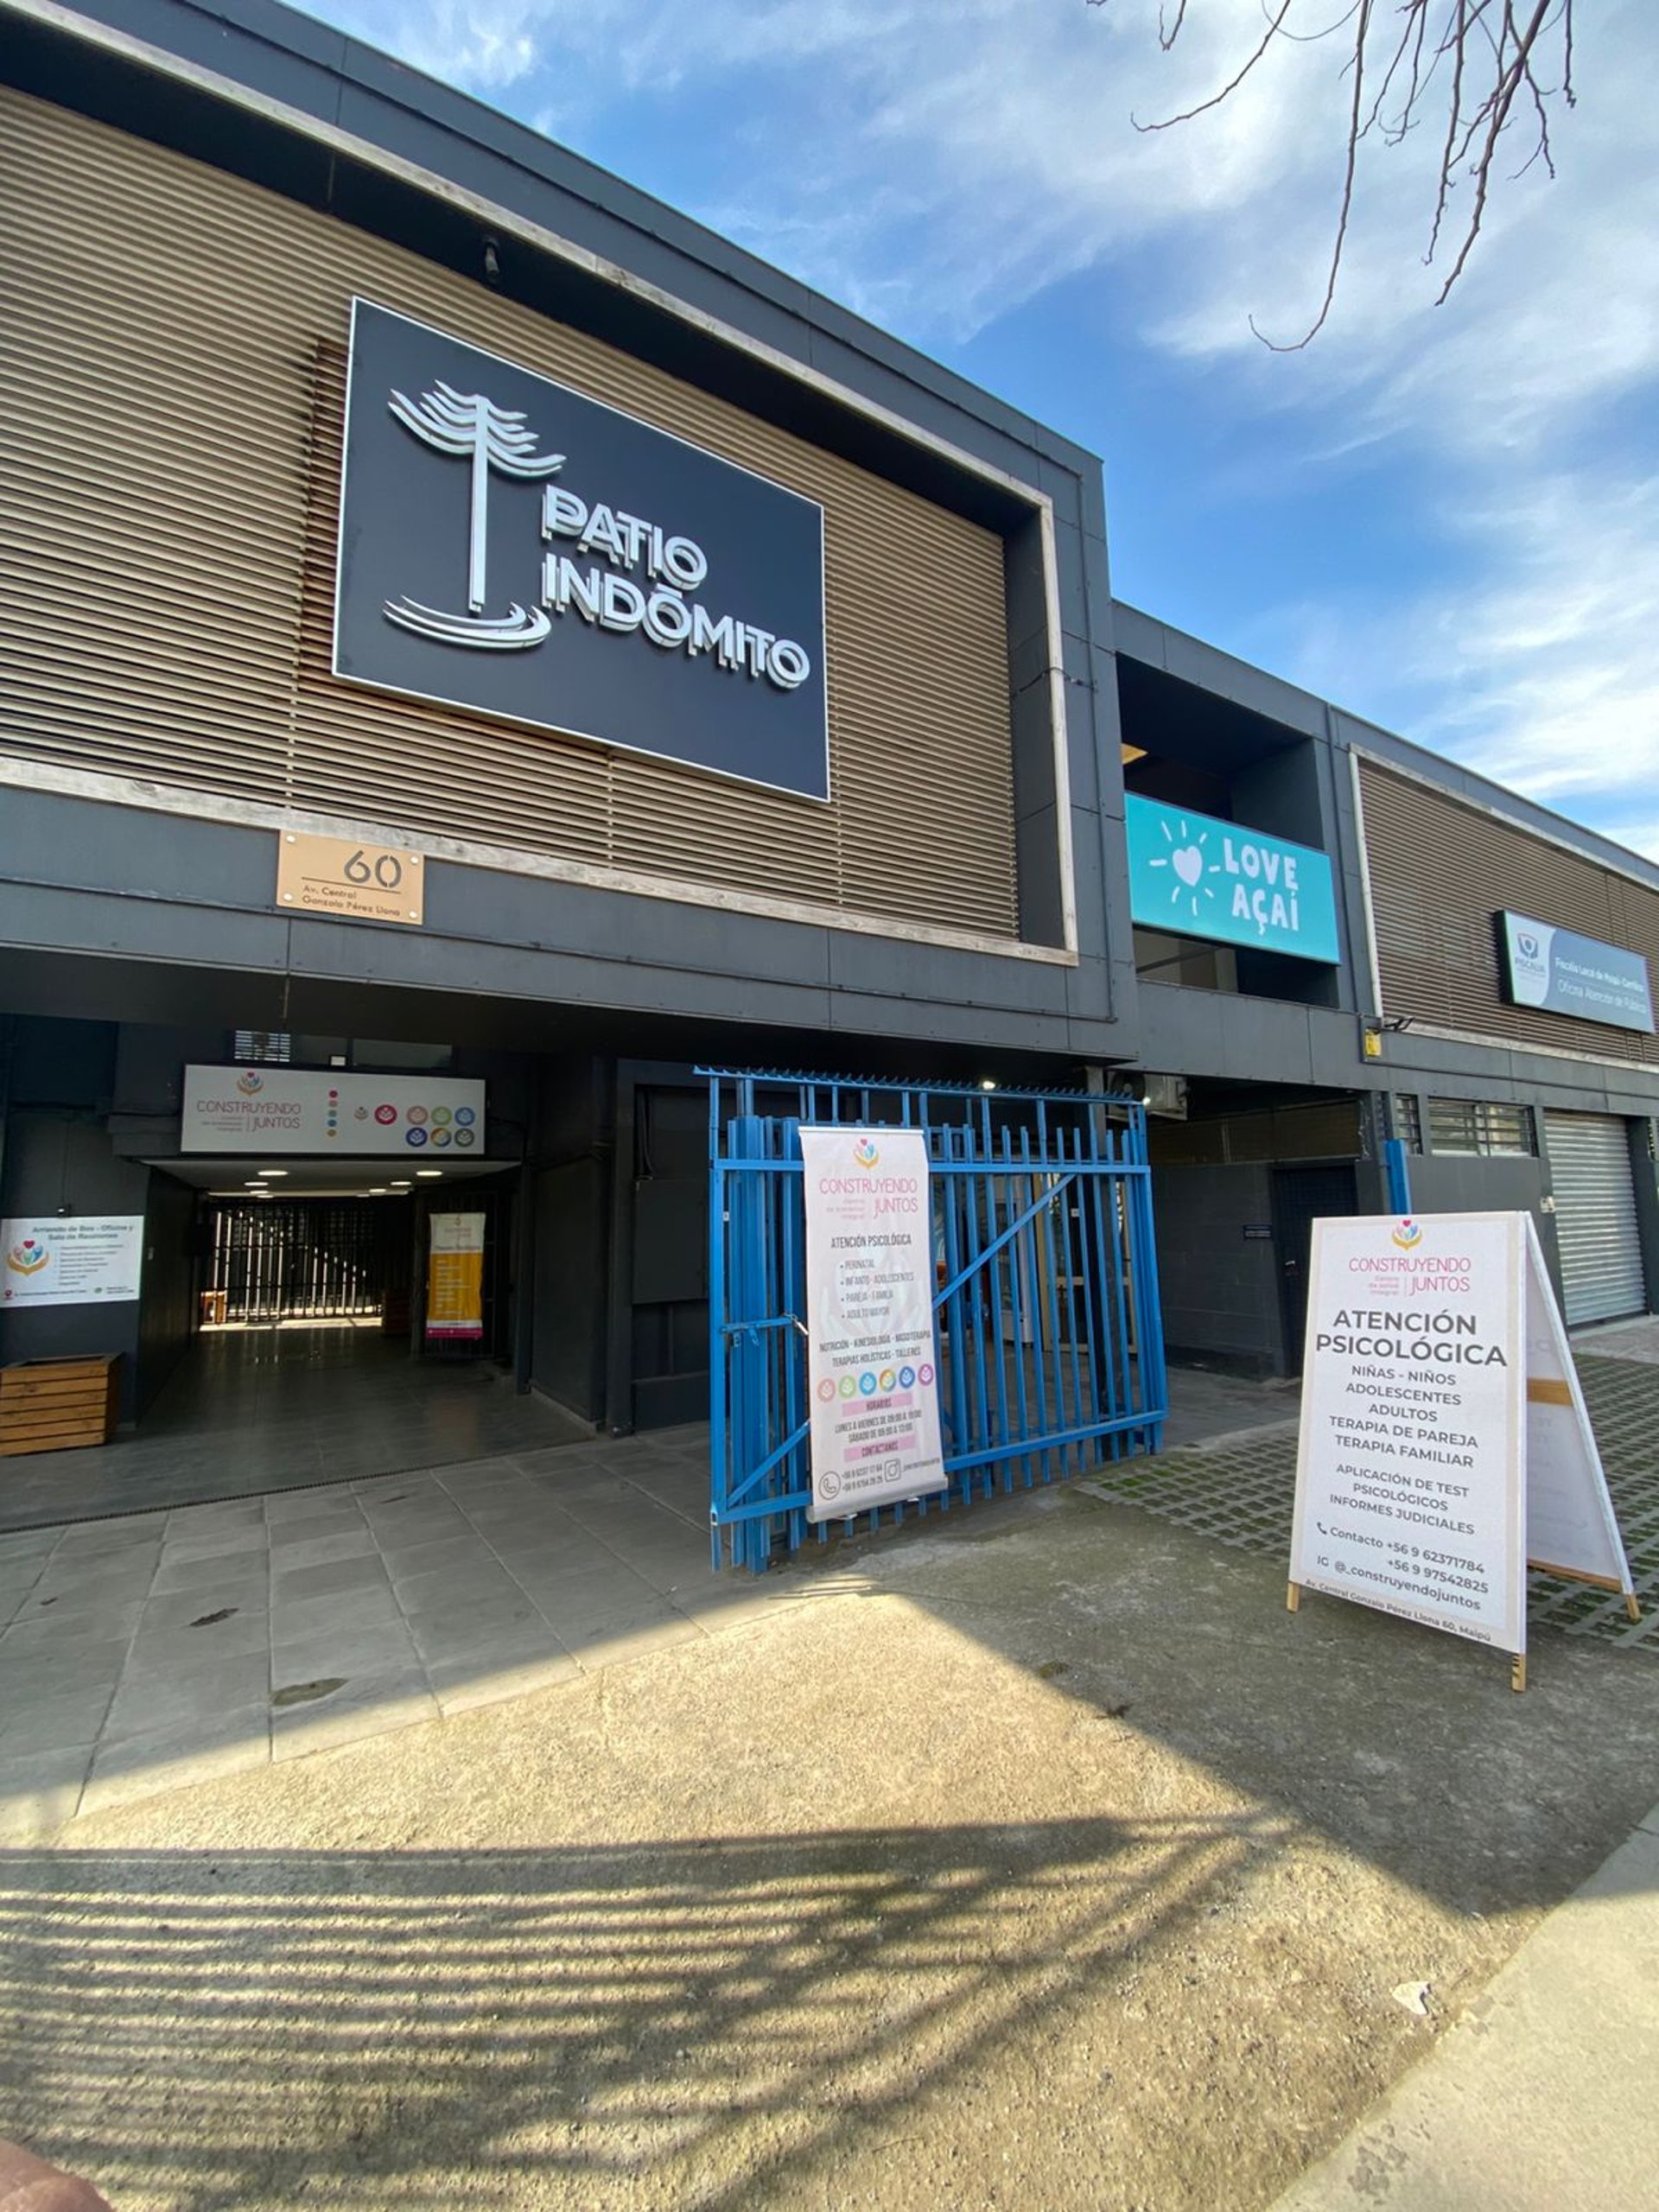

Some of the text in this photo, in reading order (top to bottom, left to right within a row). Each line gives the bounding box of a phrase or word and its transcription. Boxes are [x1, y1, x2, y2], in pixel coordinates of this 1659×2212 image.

[542, 484, 708, 590] PATIO
[344, 849, 402, 888] 60
[1223, 837, 1299, 891] LOVE
[302, 895, 344, 908] Gonzalo
[303, 885, 358, 899] Av. Central
[196, 1100, 302, 1115] CONSTRUYENDO
[252, 1117, 301, 1132] JUNTOS
[819, 1178, 918, 1194] CONSTRUYENDO
[874, 1198, 918, 1219] JUNTOS
[830, 1234, 912, 1249] ATENCIÓN PSICOLÓGICA
[844, 1259, 874, 1269] PERINATAL
[1349, 1257, 1471, 1273] CONSTRUYENDO
[874, 1272, 914, 1285] ADOLESCENTES
[1409, 1276, 1470, 1296] JUNTOS
[1332, 1309, 1477, 1335] ATENCIÓN
[1316, 1333, 1508, 1367] PSICOLÓGICA
[1351, 1364, 1395, 1379] NIÑAS
[1408, 1370, 1457, 1386] NIÑOS
[1345, 1382, 1462, 1406] ADOLESCENTES
[1368, 1403, 1438, 1422] ADULTOS
[1329, 1415, 1478, 1448] TERAPIA DE PAREJA
[1335, 1434, 1473, 1468] TERAPIA FAMILIAR
[1336, 1464, 1470, 1497] APLICACIÓN DE TEST
[1352, 1483, 1449, 1511] PSICOLÓGICOS
[1329, 1494, 1475, 1535] INFORMES JUDICIALES
[1329, 1527, 1484, 1573] Contacto +56 9 62371784
[1388, 1558, 1489, 1593] +56 9 97542825
